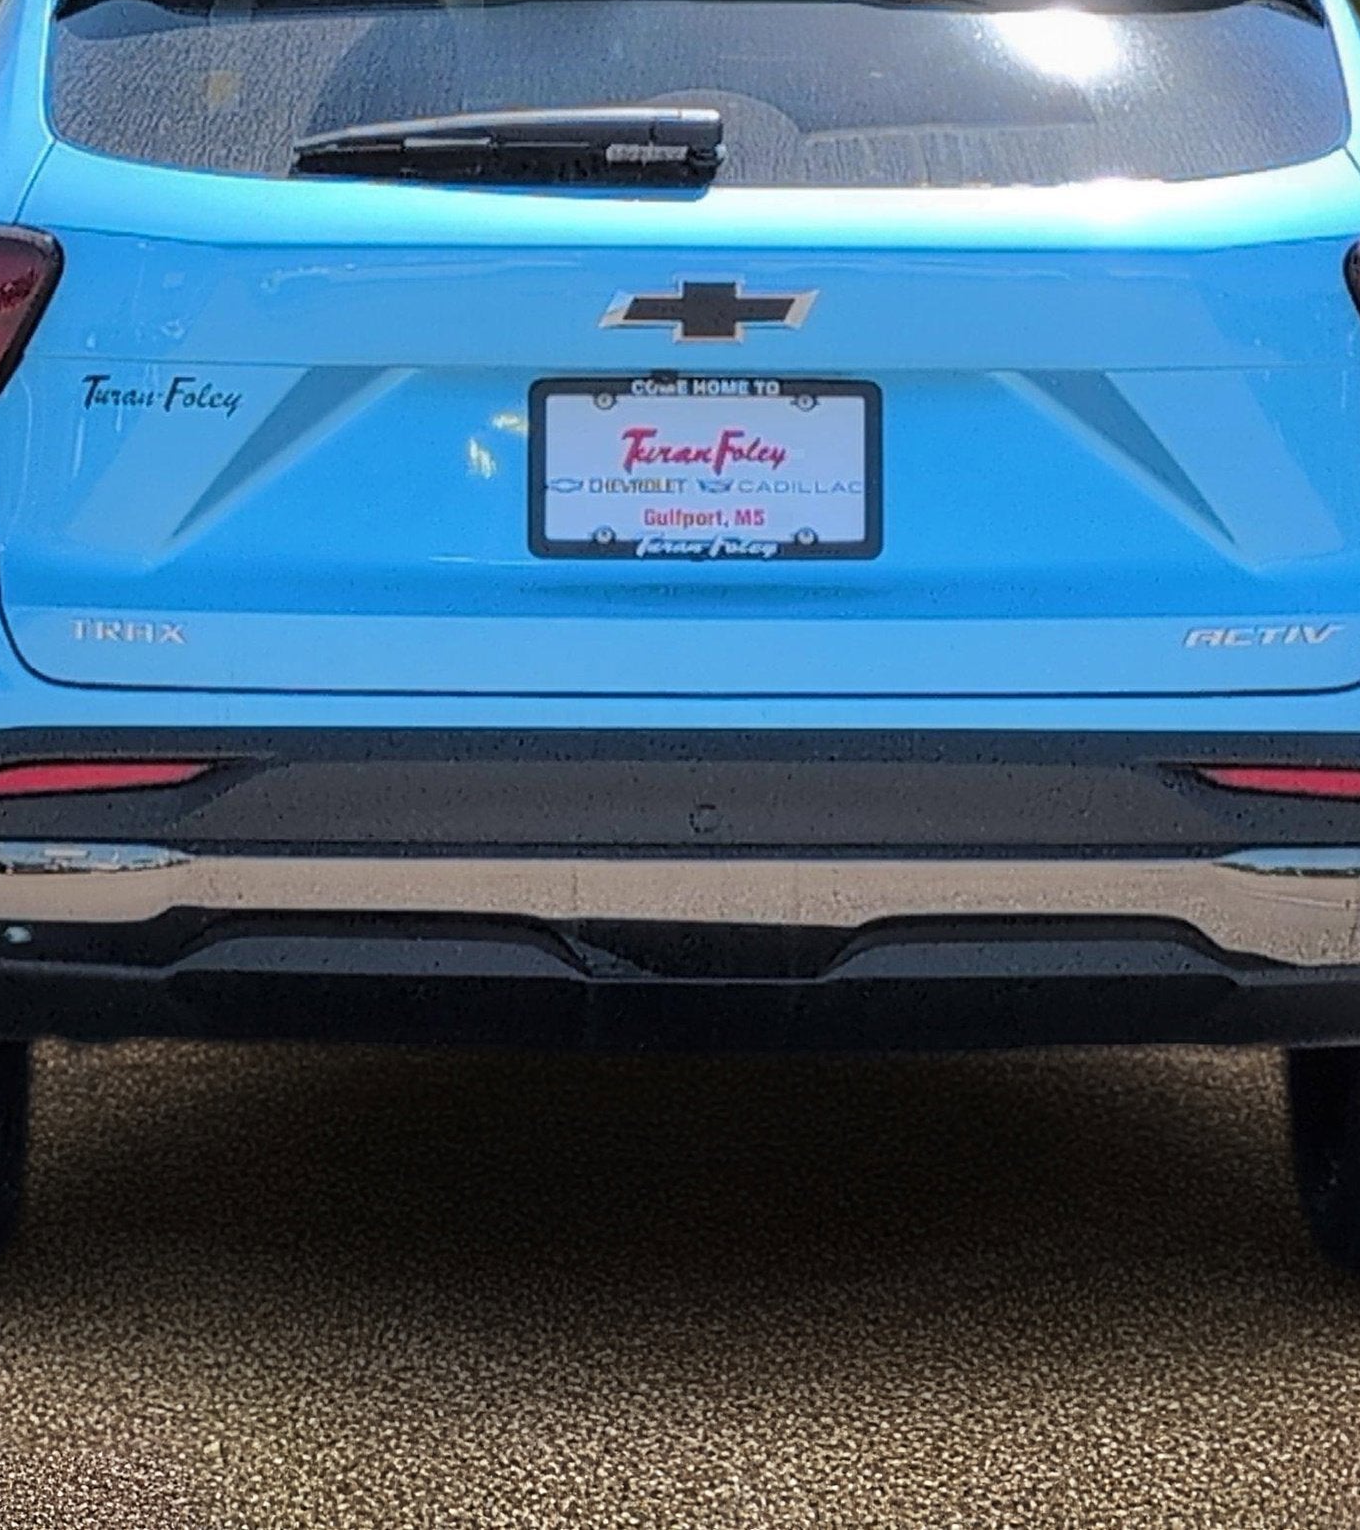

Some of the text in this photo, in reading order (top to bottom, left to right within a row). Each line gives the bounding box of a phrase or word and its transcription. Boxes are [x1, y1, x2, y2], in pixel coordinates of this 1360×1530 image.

[163, 376, 242, 418] Foley
[693, 379, 750, 396] HOME
[754, 379, 781, 396] TO
[713, 429, 787, 476] Foley
[589, 478, 863, 495] CHEVROLET CADILLAC
[643, 507, 766, 529] Gulfport, MS
[71, 618, 187, 645] TRAX
[1183, 623, 1346, 648] ACTIV
